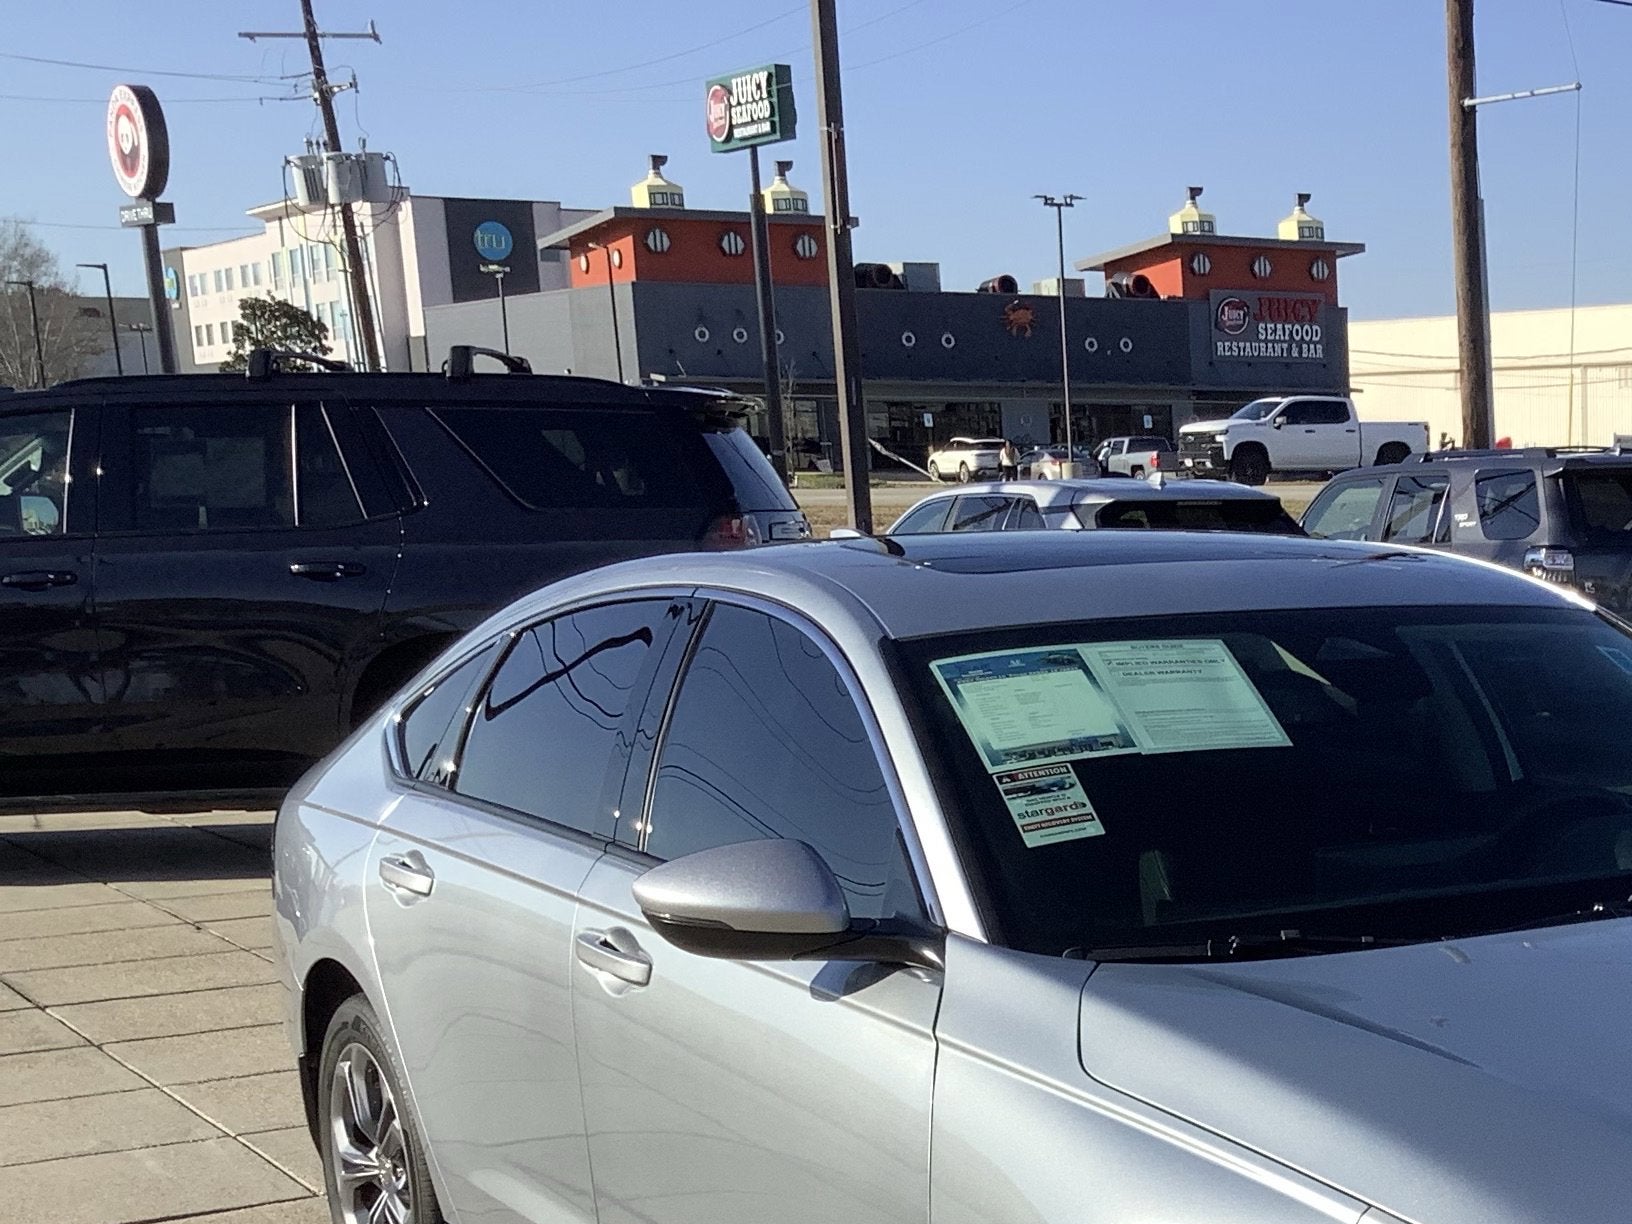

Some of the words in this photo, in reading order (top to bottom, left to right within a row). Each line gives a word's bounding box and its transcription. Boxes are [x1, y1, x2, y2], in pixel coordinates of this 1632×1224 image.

[730, 71, 768, 106] JUICY
[731, 100, 770, 125] SEAFOOD
[1253, 298, 1319, 322] JUICY
[1258, 323, 1321, 340] SEAFOOD
[1217, 341, 1288, 357] RESTAURANT
[1291, 343, 1299, 357] &
[1302, 343, 1323, 358] BAR
[1017, 766, 1068, 781] ATTENTION
[1017, 801, 1080, 819] stargard
